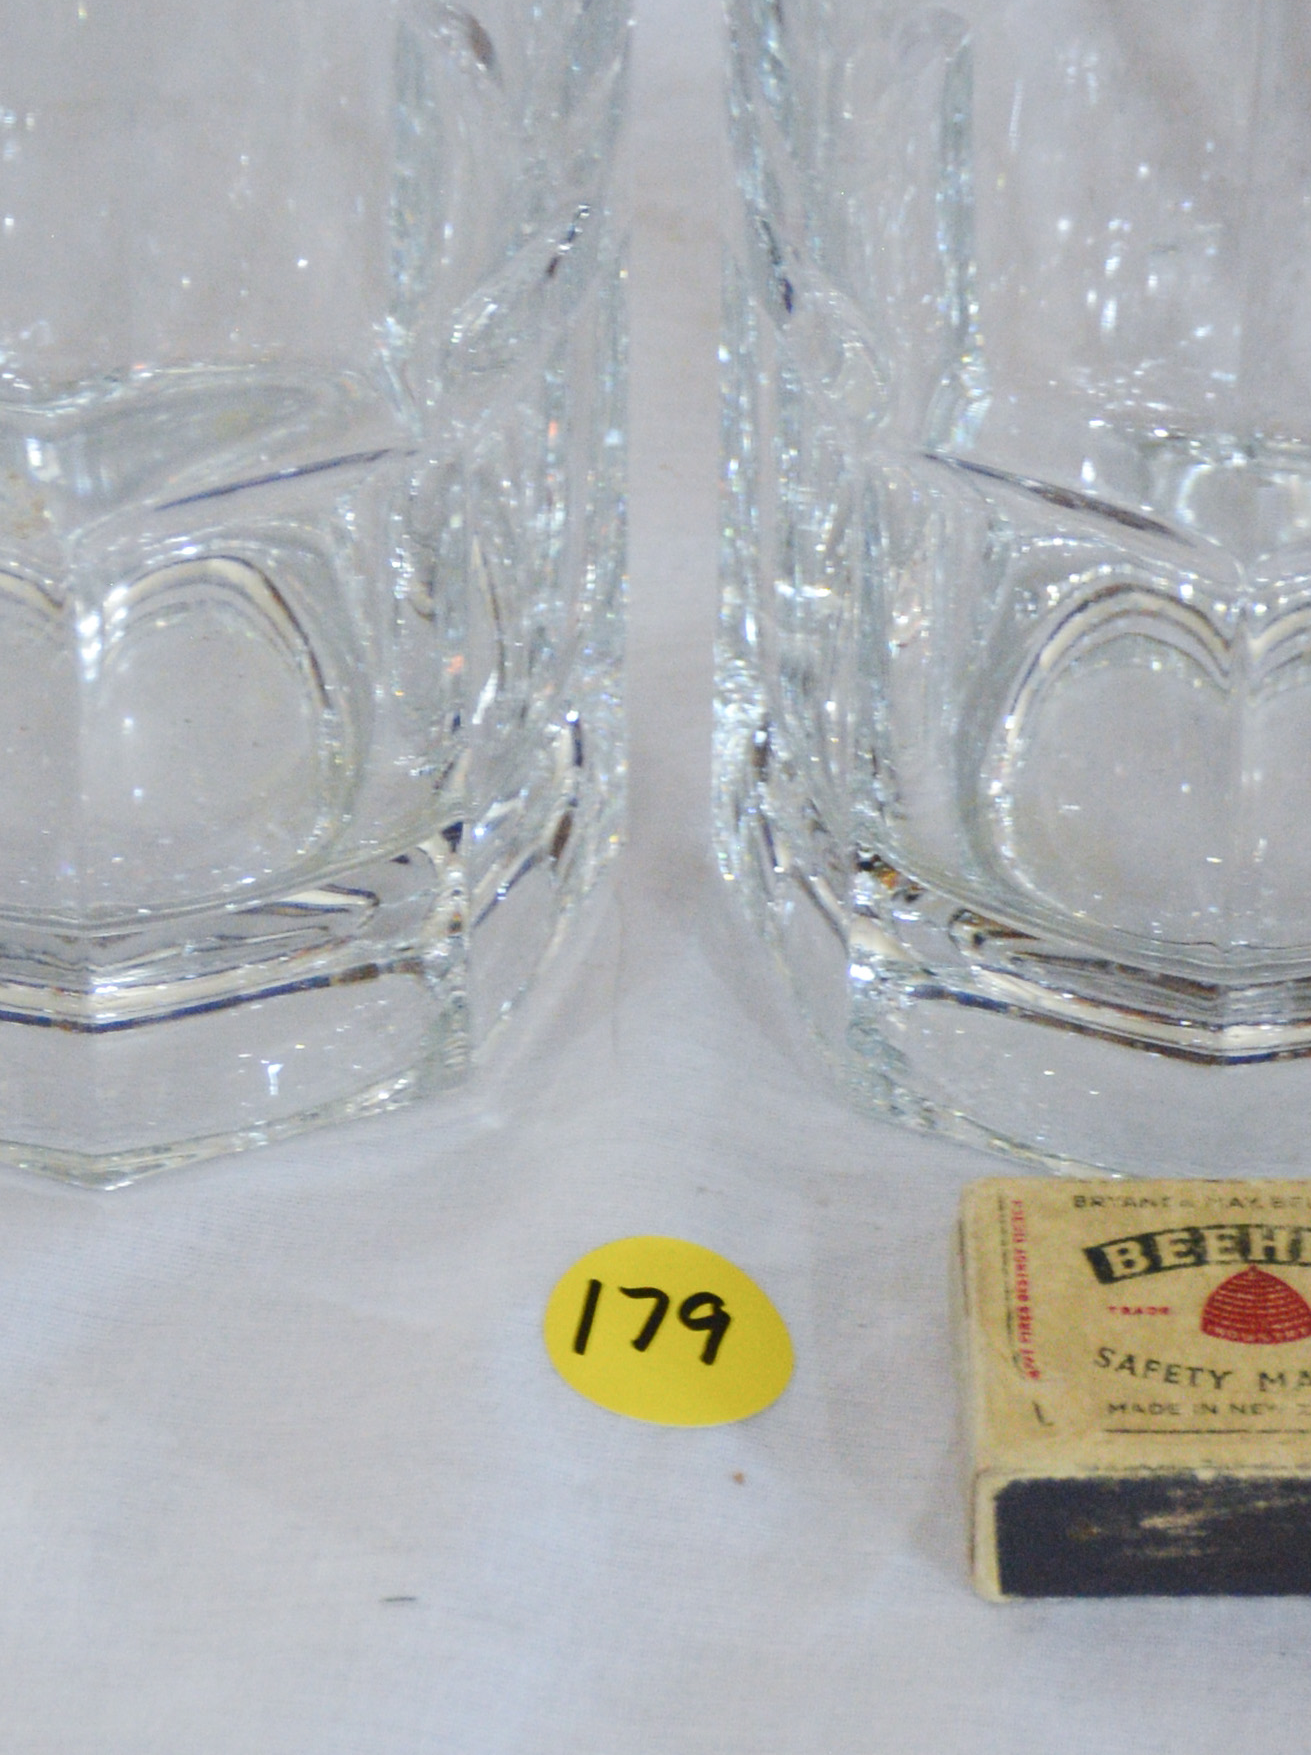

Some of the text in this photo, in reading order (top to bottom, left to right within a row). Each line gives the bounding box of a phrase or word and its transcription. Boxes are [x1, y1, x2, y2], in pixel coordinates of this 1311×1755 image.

[572, 1278, 731, 1366] 179
[1107, 1305, 1170, 1316] TRADE
[1093, 1346, 1233, 1390] SAFETY
[1107, 1401, 1182, 1416] MADE
